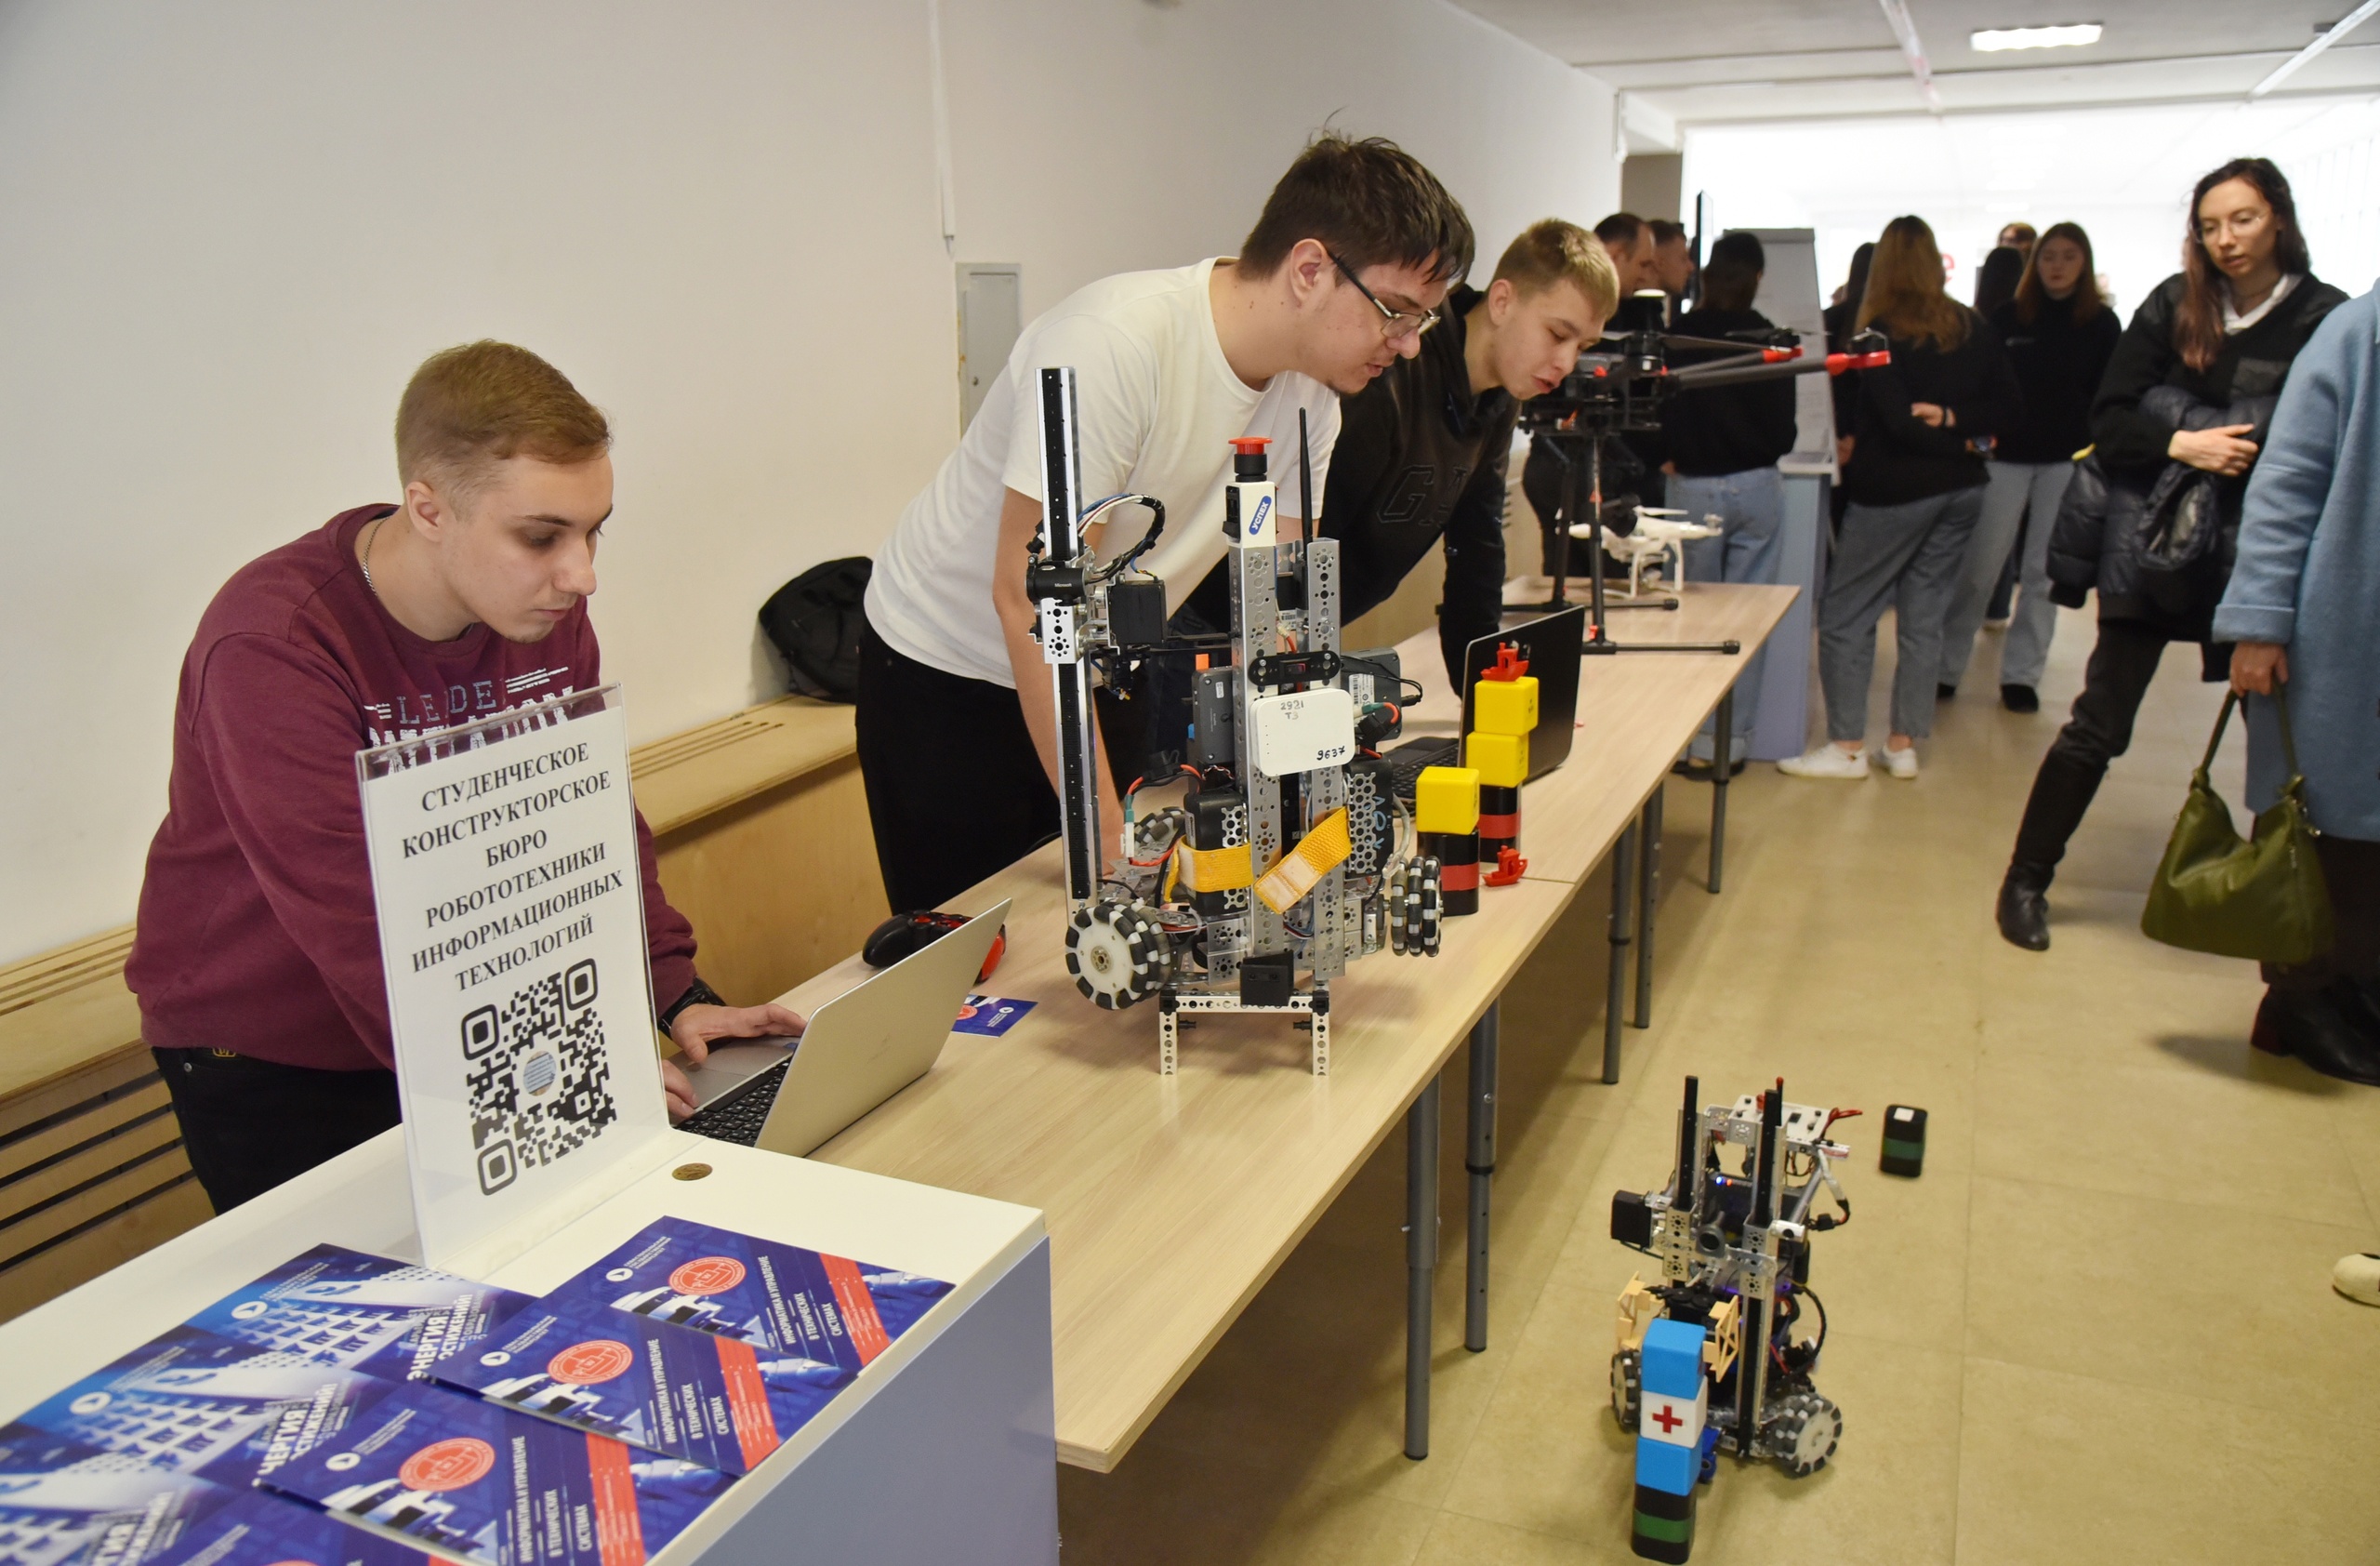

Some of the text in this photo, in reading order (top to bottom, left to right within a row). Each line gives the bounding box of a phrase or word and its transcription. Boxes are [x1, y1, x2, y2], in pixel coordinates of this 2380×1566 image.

[1251, 501, 1269, 530] УСПЕХ
[1280, 700, 1304, 710] 2921
[1316, 745, 1345, 761] 9637
[421, 742, 589, 812] СТУДЕНЧЕСКОЕ
[402, 771, 612, 858] КОНСТРУКТОРСКОЕ
[484, 829, 548, 868] БЮРО
[425, 842, 606, 929] РОБОТОТЕХНИКИ
[411, 869, 624, 973] ИНФОРМАЦИОННЫХ
[455, 912, 595, 991] ТЕХНОЛОГИЙ
[758, 1255, 780, 1293] УПРАВЛЕНИЕ
[771, 1298, 797, 1345] ИНФОРМАТИКА
[793, 1292, 818, 1334] ТЕХНИЧЕСКИХ
[821, 1302, 843, 1336] СИСТЕМАХ
[406, 1316, 449, 1381] ЭНЕРГИЯ
[647, 1339, 666, 1383] УПРАВЛЕНИЕ
[656, 1390, 677, 1444] ИНФОРМАТИКА
[681, 1384, 702, 1432] ТЕХНИЧЕСКИХ
[709, 1396, 730, 1435] СИСТЕМАХ
[512, 1436, 528, 1489] УПРАВЛЕНИЕ
[516, 1497, 534, 1563] ИНФОРМАТИКА
[544, 1489, 563, 1558] В ТЕХНИЧЕСКИХ
[574, 1504, 592, 1551] СИСТЕМАХ
